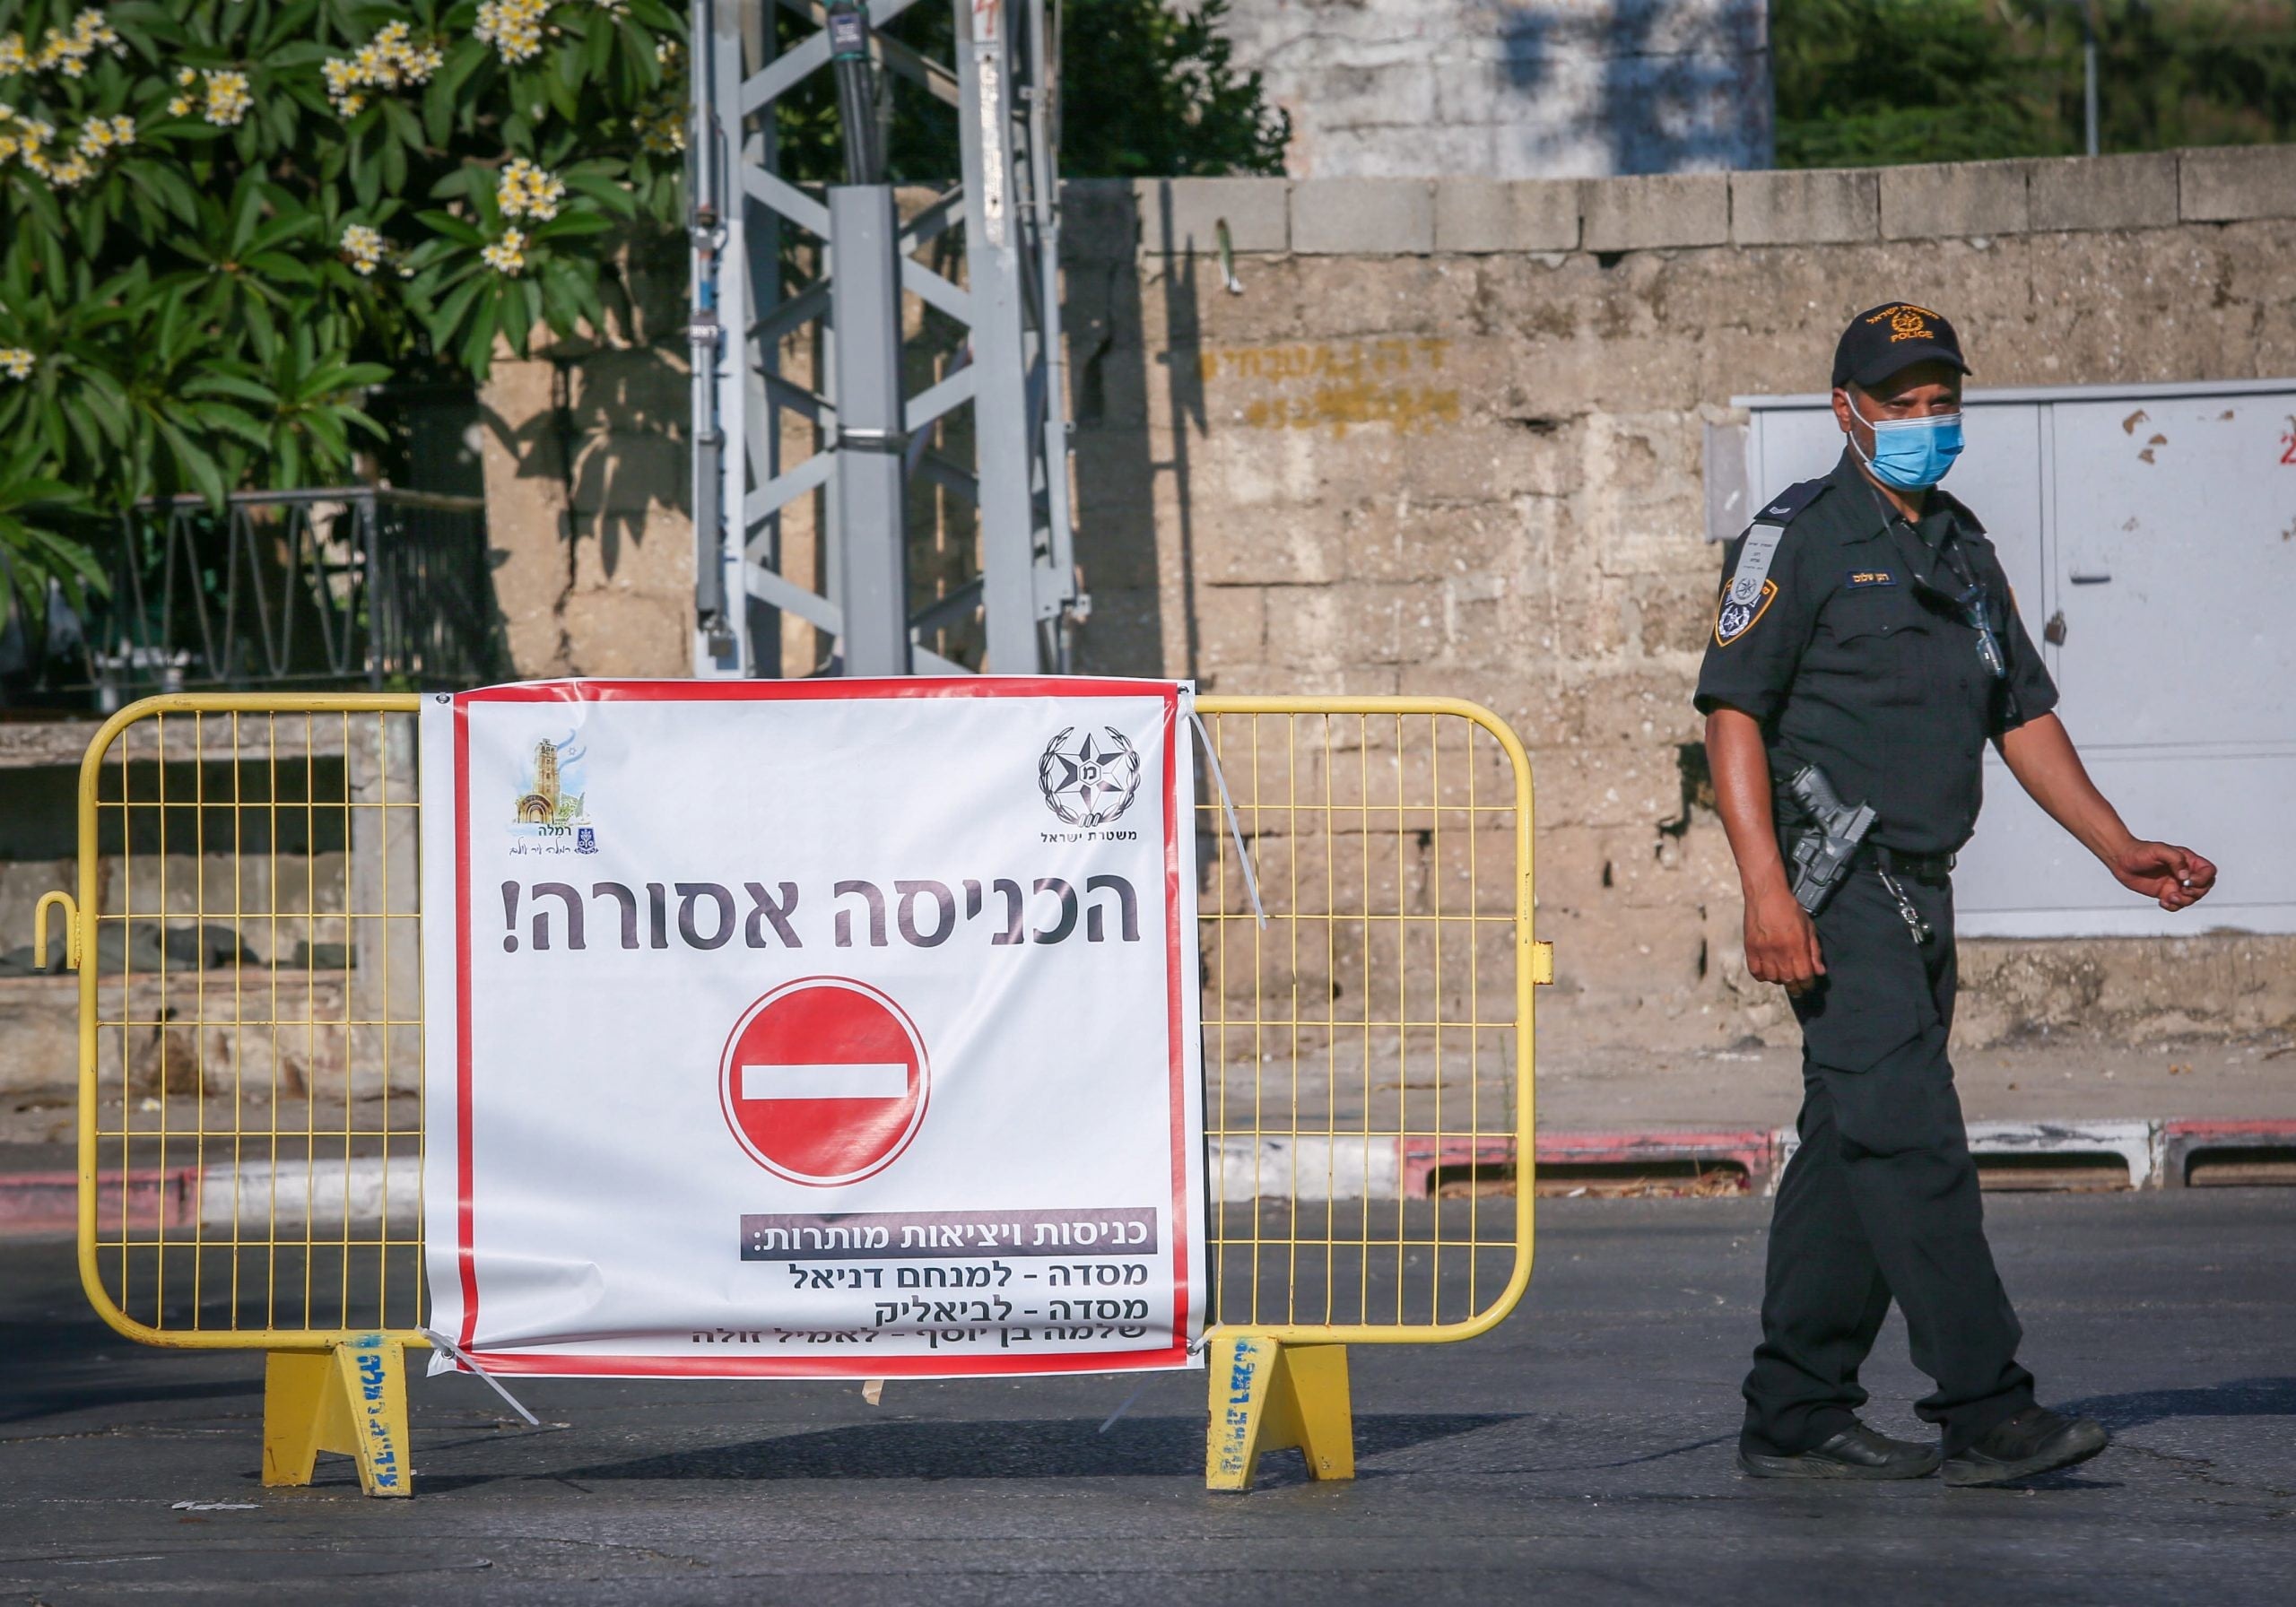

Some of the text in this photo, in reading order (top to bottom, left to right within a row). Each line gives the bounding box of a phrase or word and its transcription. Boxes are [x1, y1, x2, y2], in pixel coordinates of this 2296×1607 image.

[1865, 306, 1899, 325] ישראל
[1890, 330, 1935, 343] POLICE
[538, 824, 571, 836] רמלה
[1040, 830, 1137, 843] משטרת ישראל
[545, 837, 571, 855] רמלה
[500, 873, 1141, 953] הכניסה אסורה!
[753, 1218, 1149, 1252] כניסות ויציאות מותרות:
[788, 1263, 884, 1290] דניאל
[897, 1260, 1013, 1289] למנחם
[1048, 1264, 1148, 1287] מסדה
[874, 1294, 1013, 1328] לביאליק
[1049, 1299, 1149, 1321] מסדה
[691, 1327, 762, 1343] זולה
[775, 1326, 880, 1343] לאמיל
[917, 1326, 987, 1349] יוסף
[1000, 1326, 1032, 1348] בן
[1044, 1323, 1147, 1341] שלמה
